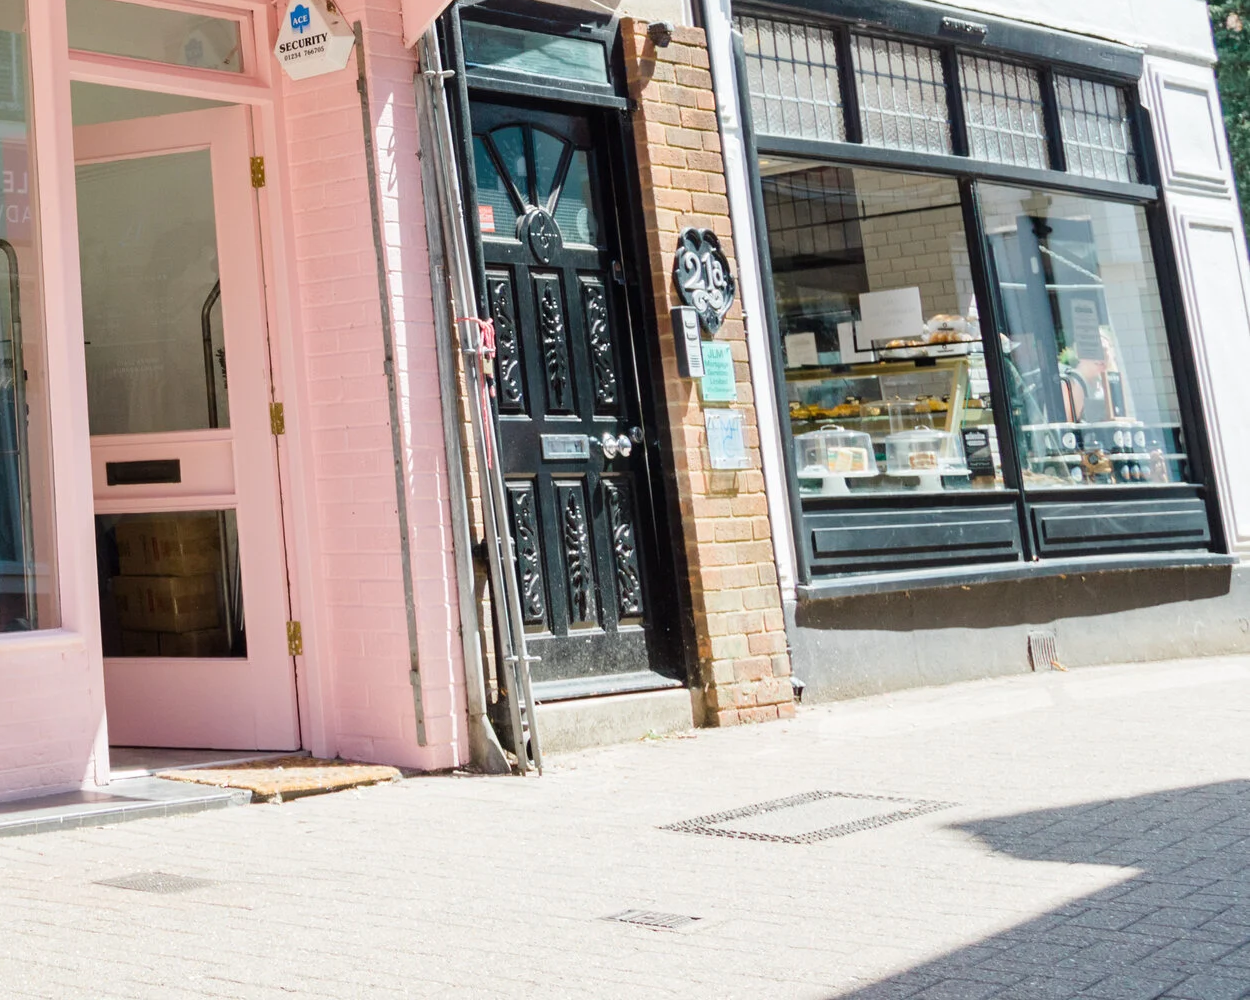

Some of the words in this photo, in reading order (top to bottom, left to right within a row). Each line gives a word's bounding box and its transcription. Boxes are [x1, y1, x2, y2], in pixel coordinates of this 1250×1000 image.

[292, 14, 308, 25] ACE
[279, 32, 328, 53] SECURITY
[284, 52, 301, 61] 01234
[683, 251, 726, 291] 21a
